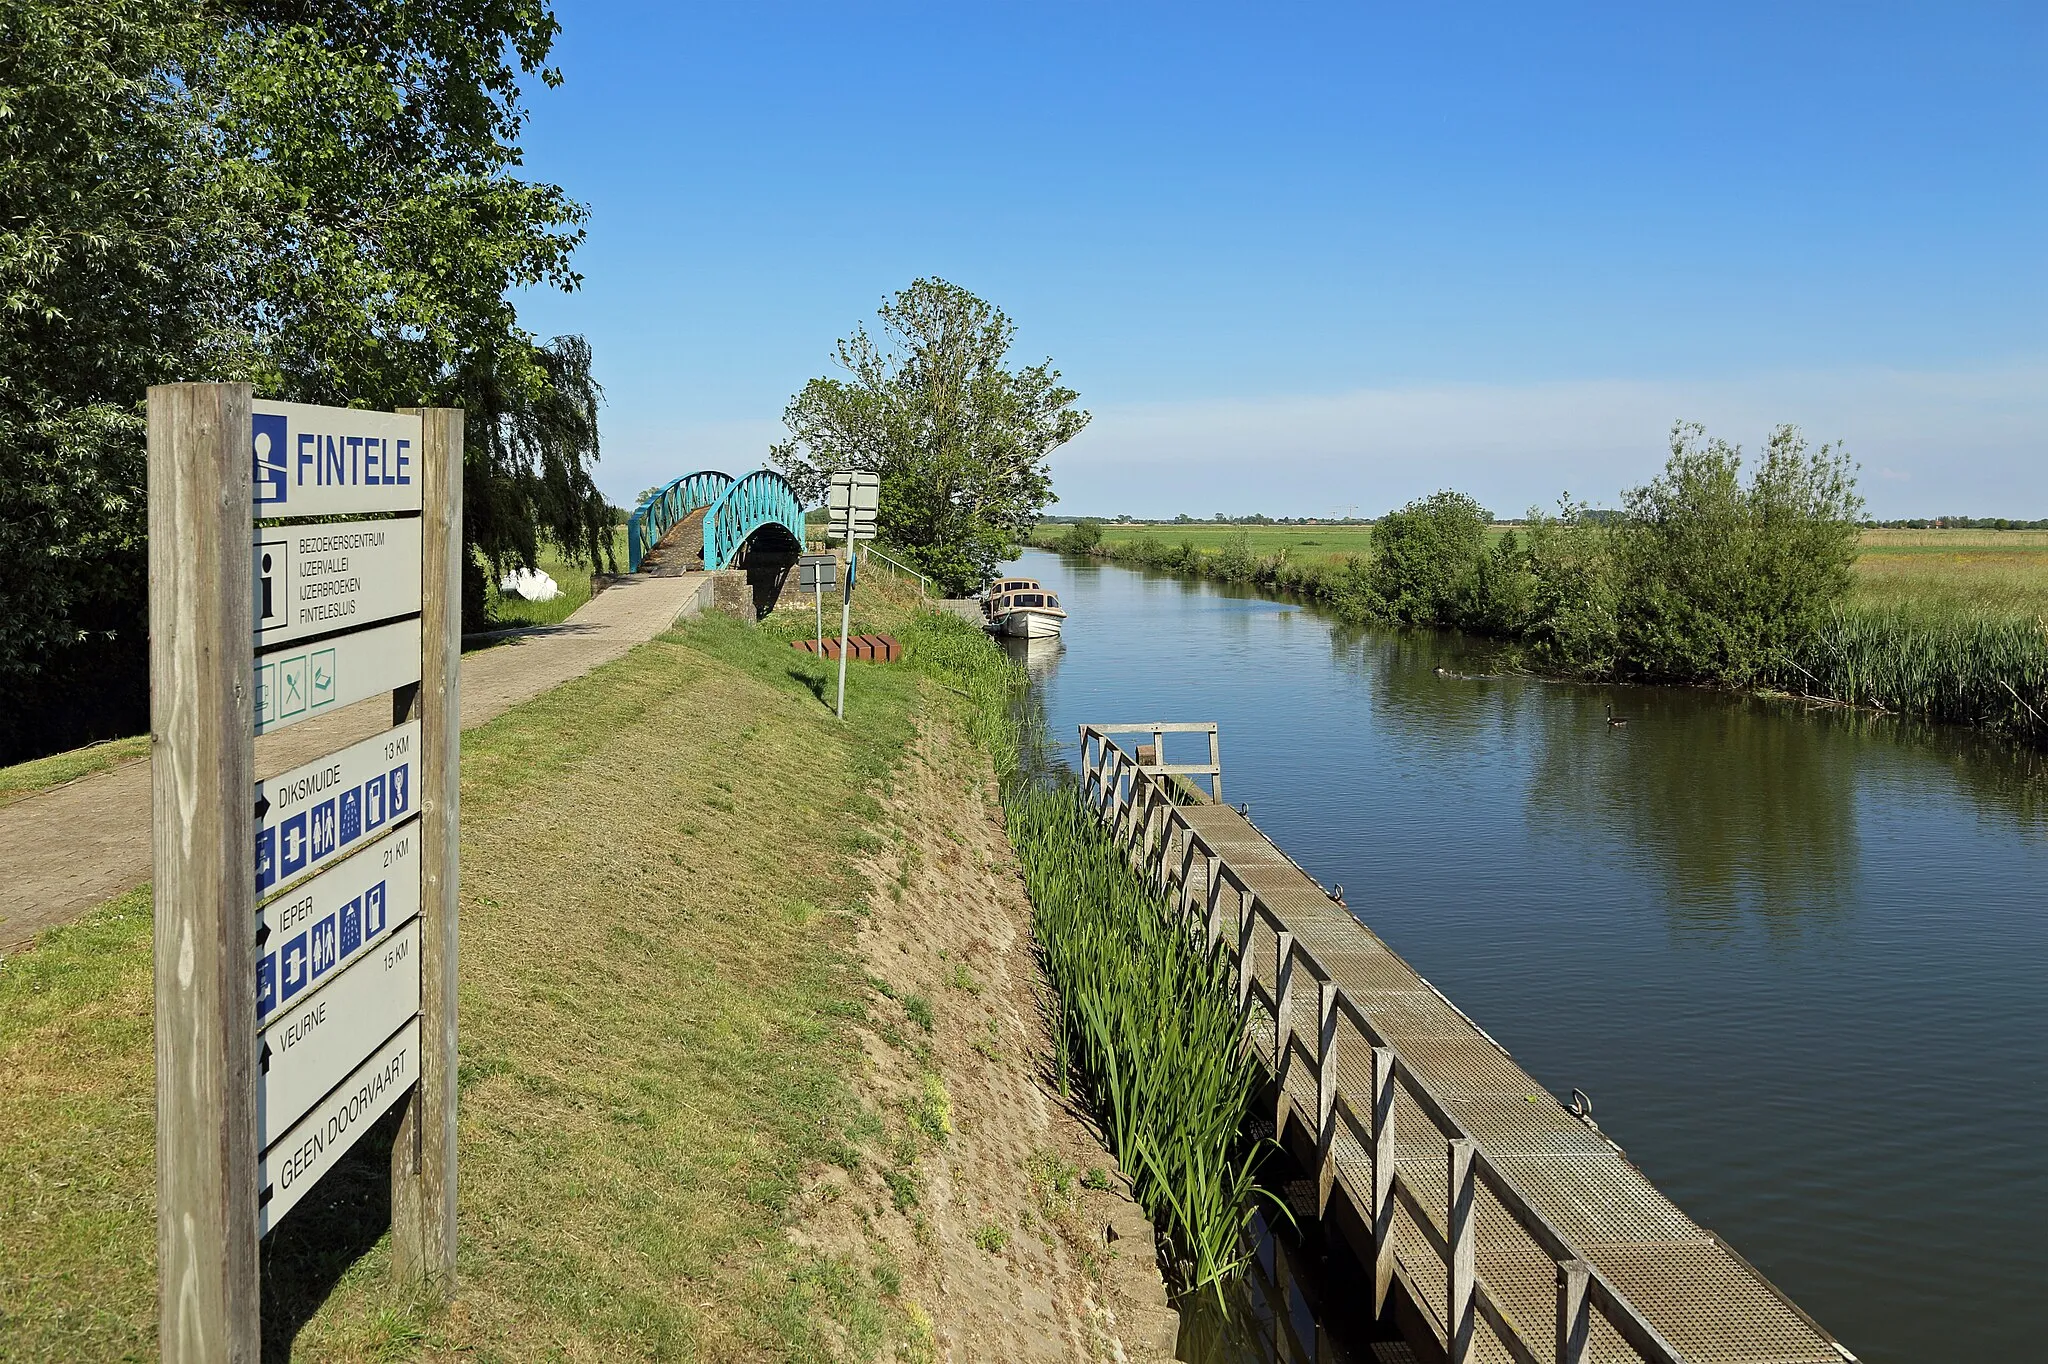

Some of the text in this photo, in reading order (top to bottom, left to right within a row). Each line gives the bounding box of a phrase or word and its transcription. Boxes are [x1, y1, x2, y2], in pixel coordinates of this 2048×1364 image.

[297, 433, 411, 486] FINTELE
[299, 532, 385, 554] BEZOEKERSCENTRUM
[299, 557, 349, 577] IJZERVALLEI
[299, 577, 361, 601] IJZERBROEKEN
[299, 600, 355, 624] FINTELESLUIS
[384, 736, 409, 760] 13 KM
[278, 764, 341, 809] DIKSMUIDE
[383, 839, 409, 869] 21 KM
[279, 895, 313, 932] IEPER
[383, 939, 409, 972] 15 KM
[280, 1002, 326, 1053] VEURNE
[280, 1048, 407, 1190] GEEN DOORVAART
